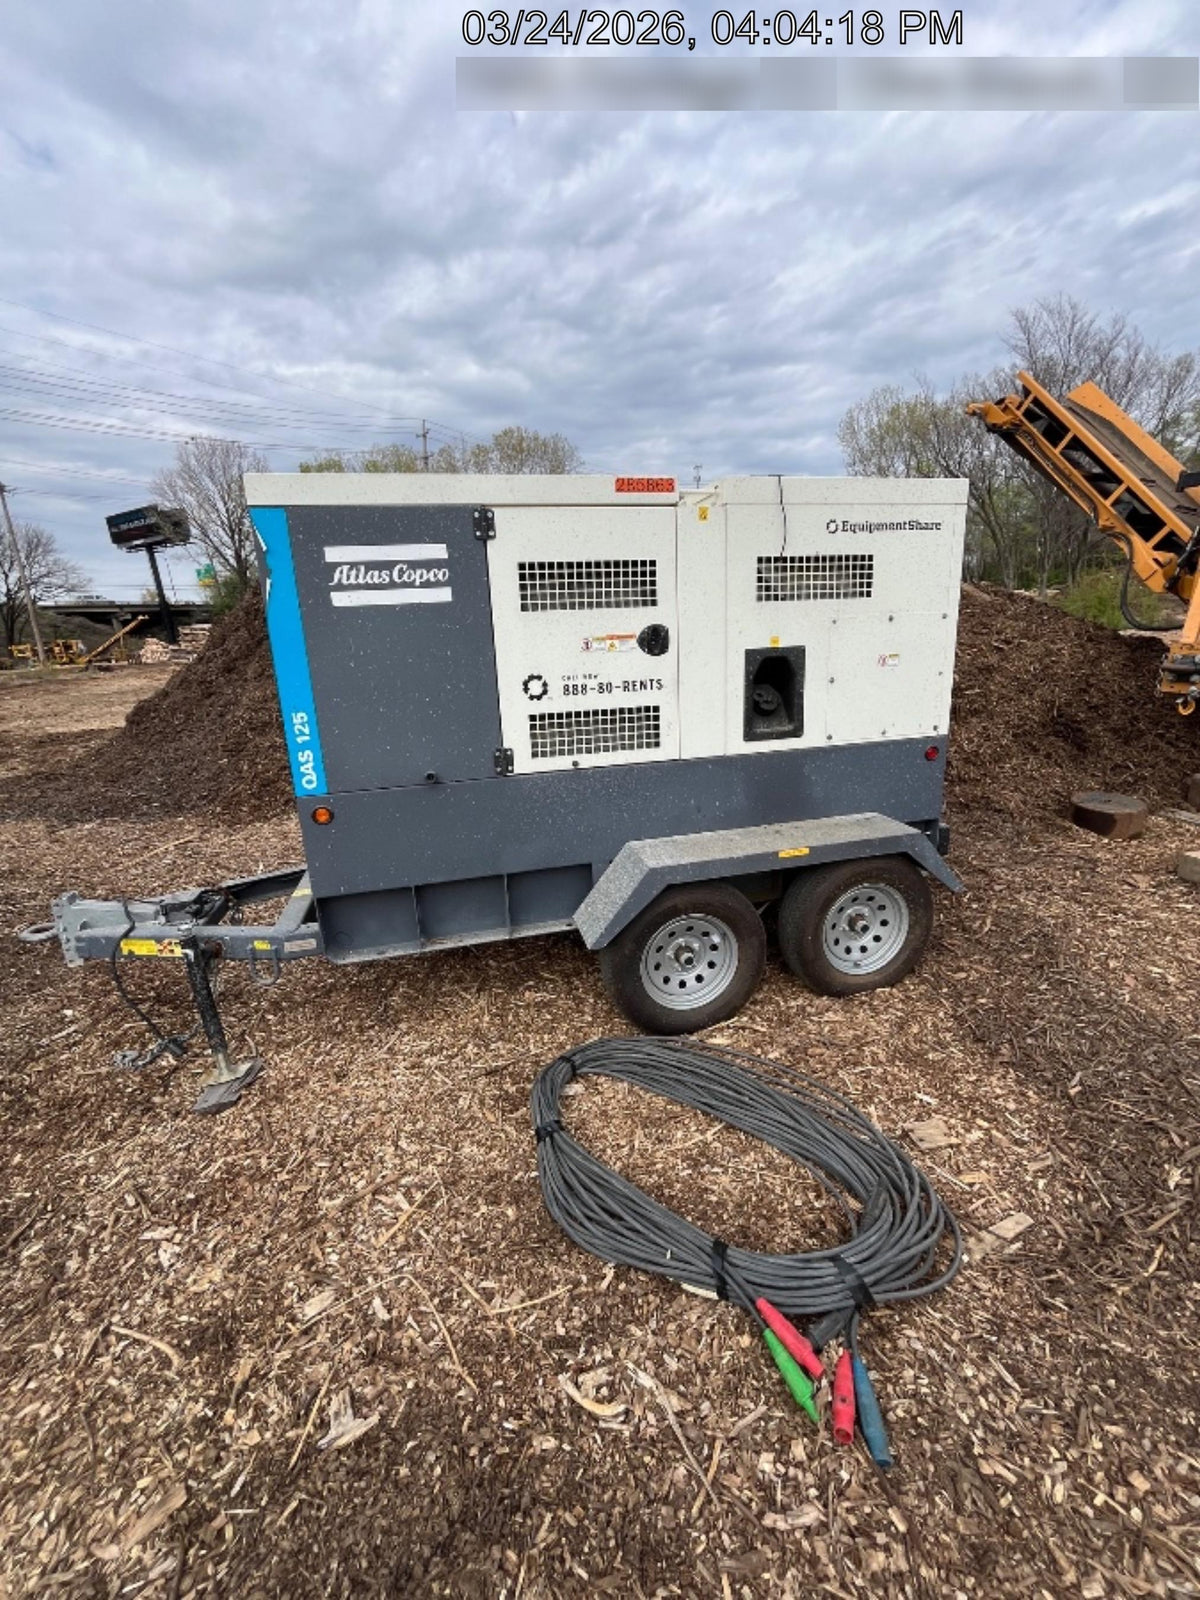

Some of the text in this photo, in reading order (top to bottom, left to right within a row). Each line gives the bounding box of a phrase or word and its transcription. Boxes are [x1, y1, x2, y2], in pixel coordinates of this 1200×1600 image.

[841, 519, 942, 534] EquipmentShare
[328, 563, 449, 587] Atlas Copco
[562, 678, 664, 696] 888-80-RENTS
[291, 711, 318, 790] QAS 125
